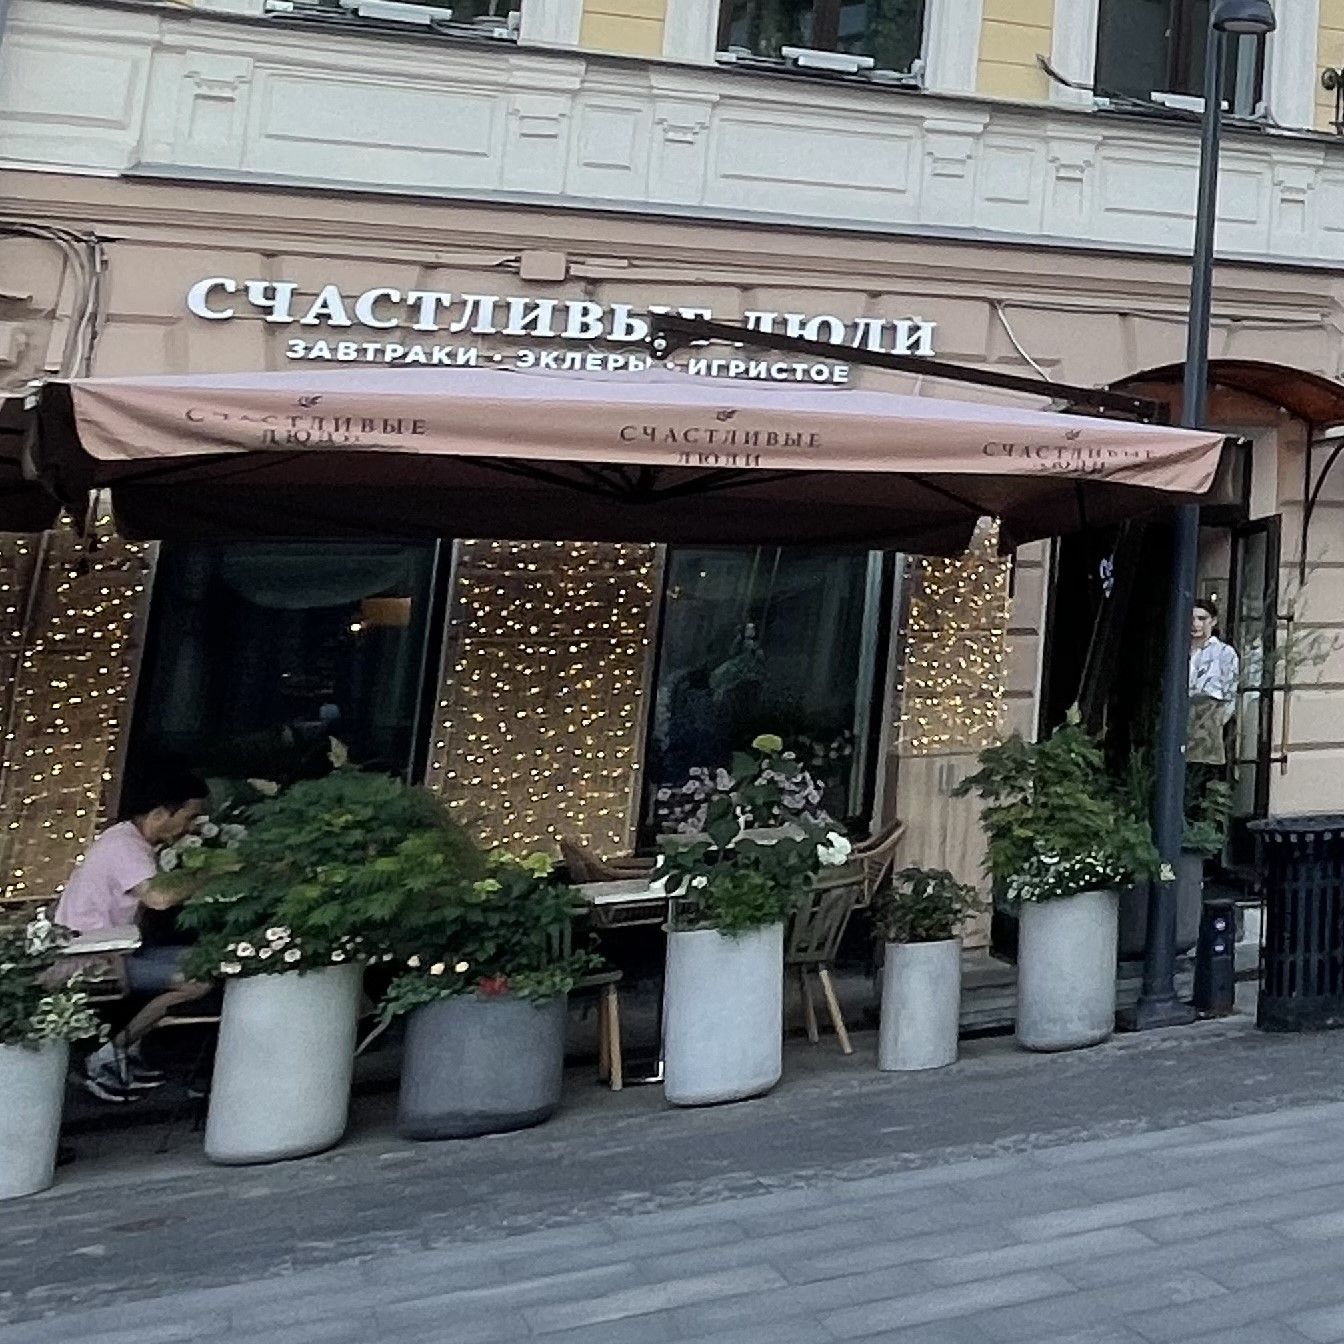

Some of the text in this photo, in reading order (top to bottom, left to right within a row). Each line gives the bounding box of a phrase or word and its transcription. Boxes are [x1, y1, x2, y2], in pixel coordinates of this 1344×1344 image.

[286, 339, 850, 383] ЗАВТРАКИ ЭКЛЕРЫ ИГРИСТОЕ
[619, 424, 825, 449] СЧАСТЛИВЫЕ
